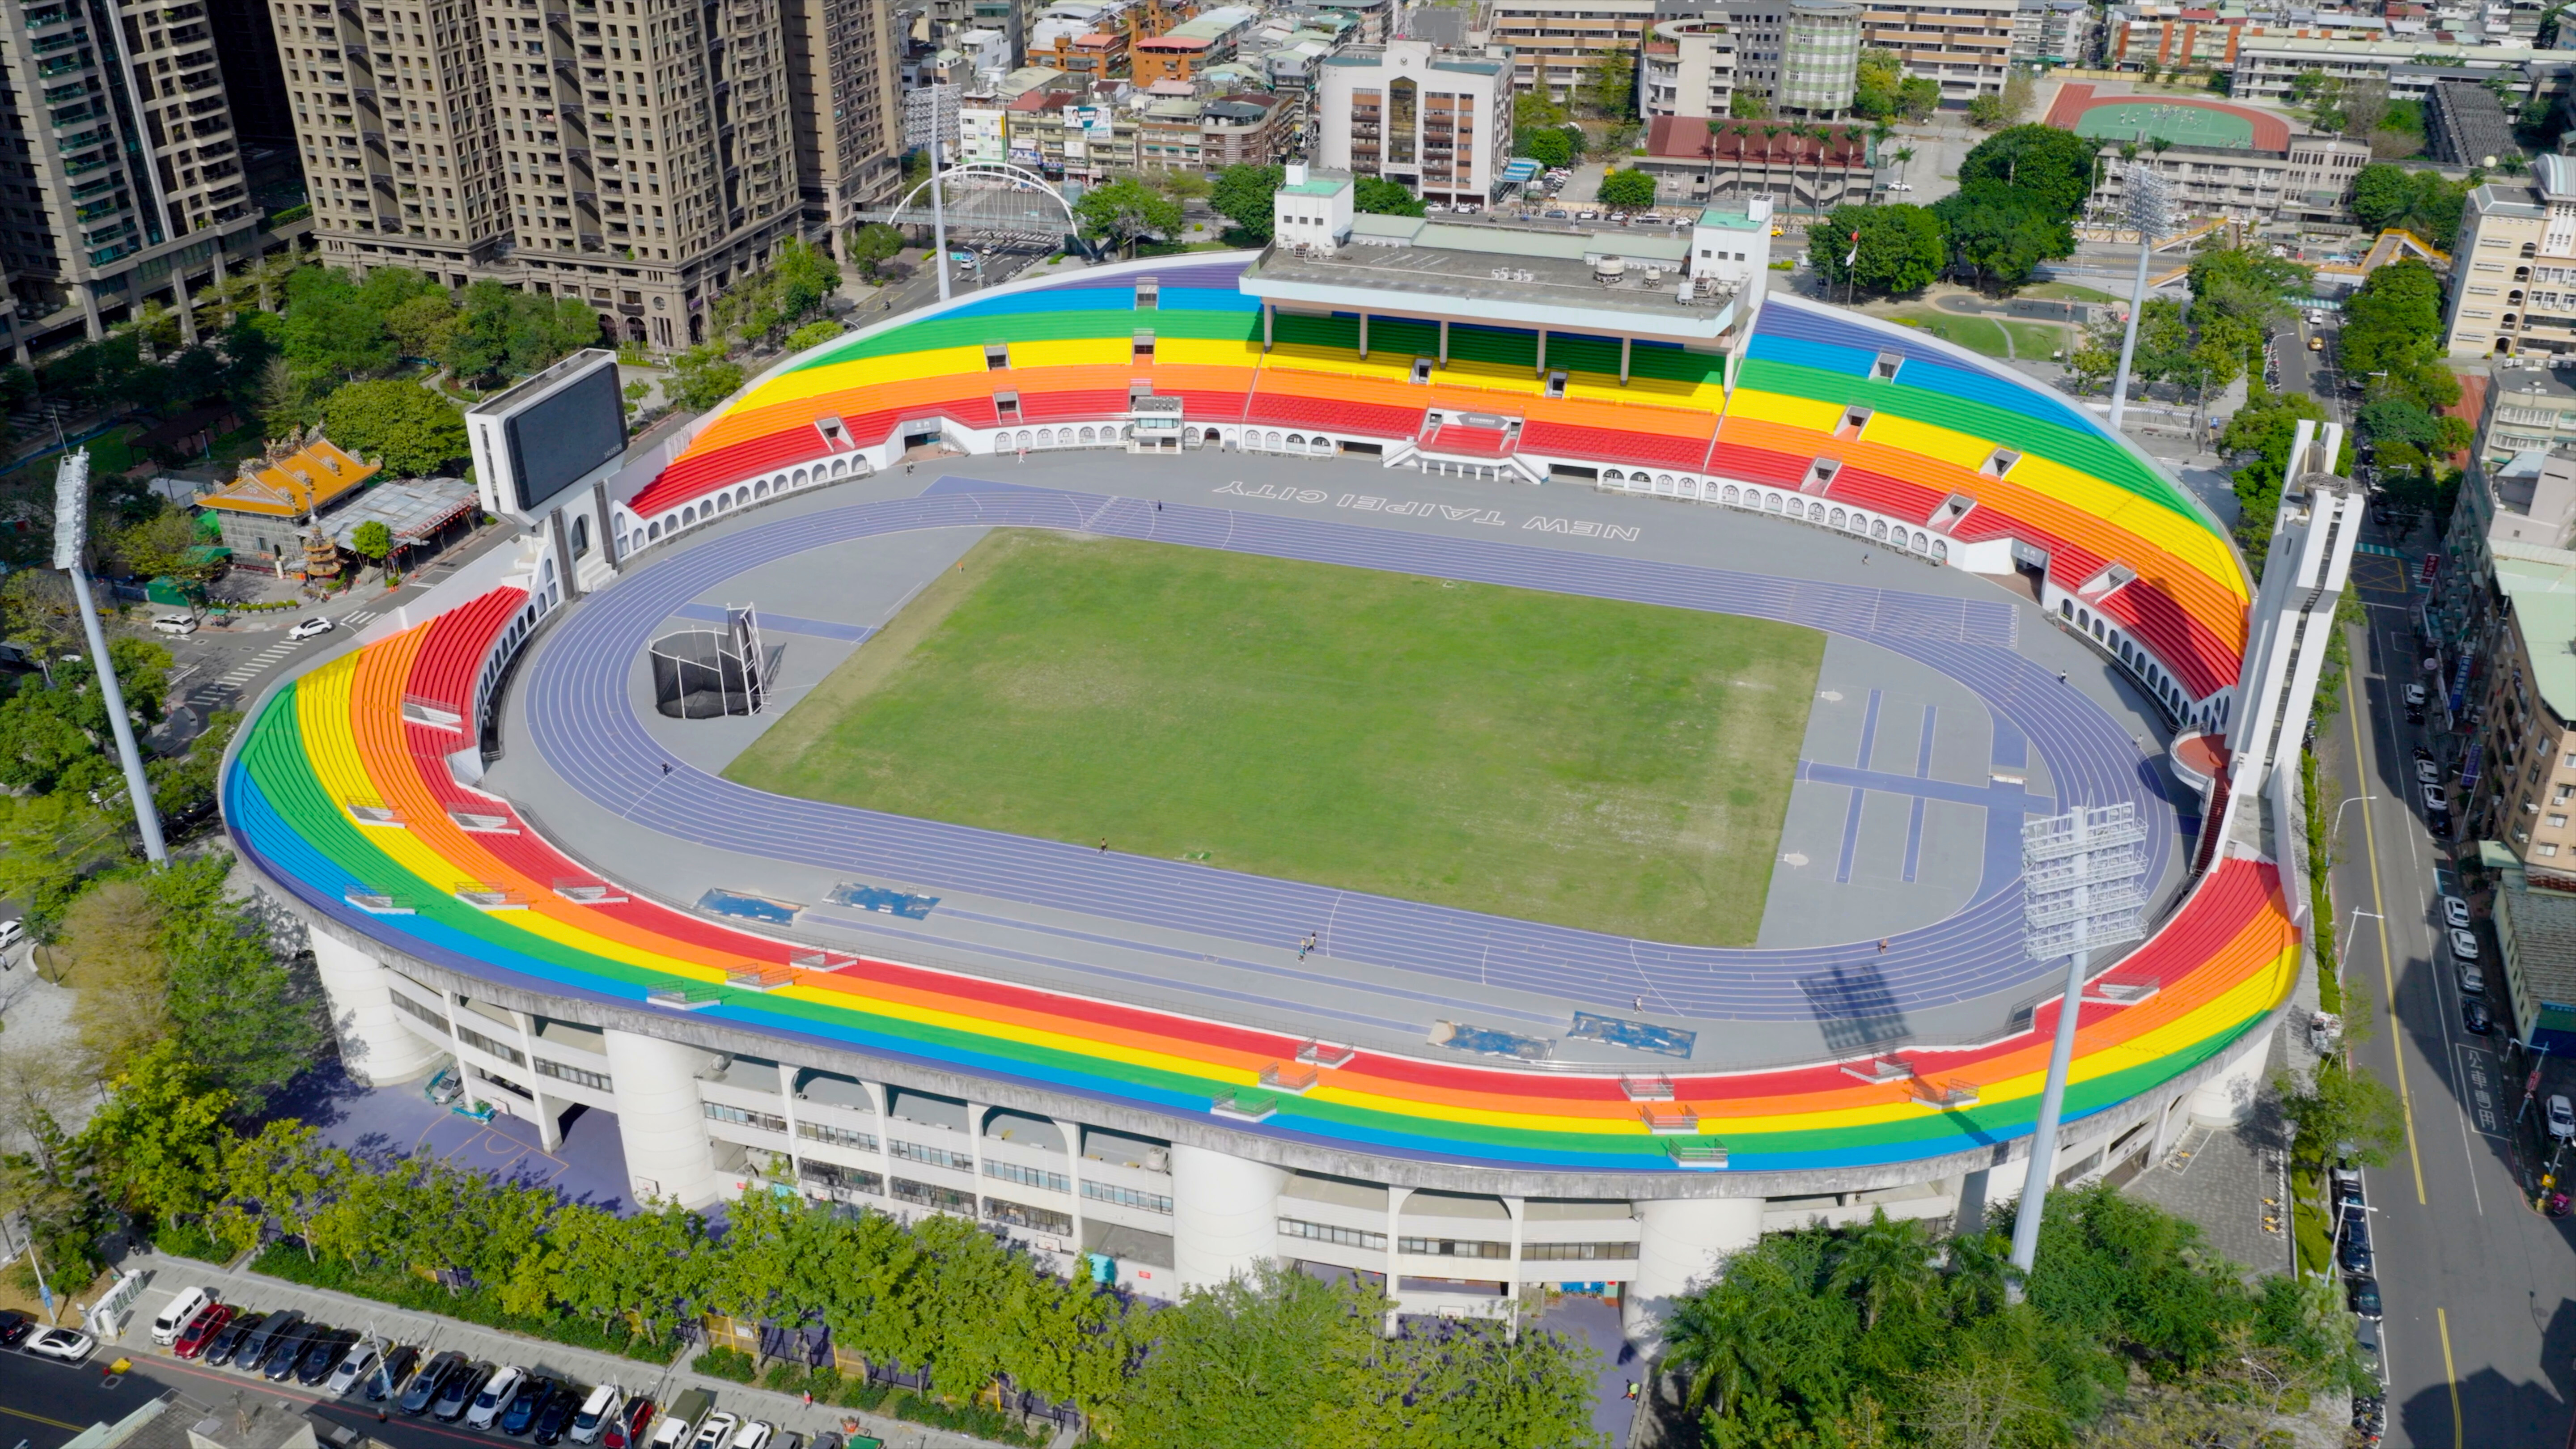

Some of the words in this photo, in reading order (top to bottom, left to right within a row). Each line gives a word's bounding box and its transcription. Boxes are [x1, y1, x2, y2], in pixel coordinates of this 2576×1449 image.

[1212, 481, 1327, 503] CITY
[1337, 494, 1505, 525] TAIPEI
[1522, 516, 1640, 541] NEW
[2469, 1050, 2496, 1131] 公車專用
